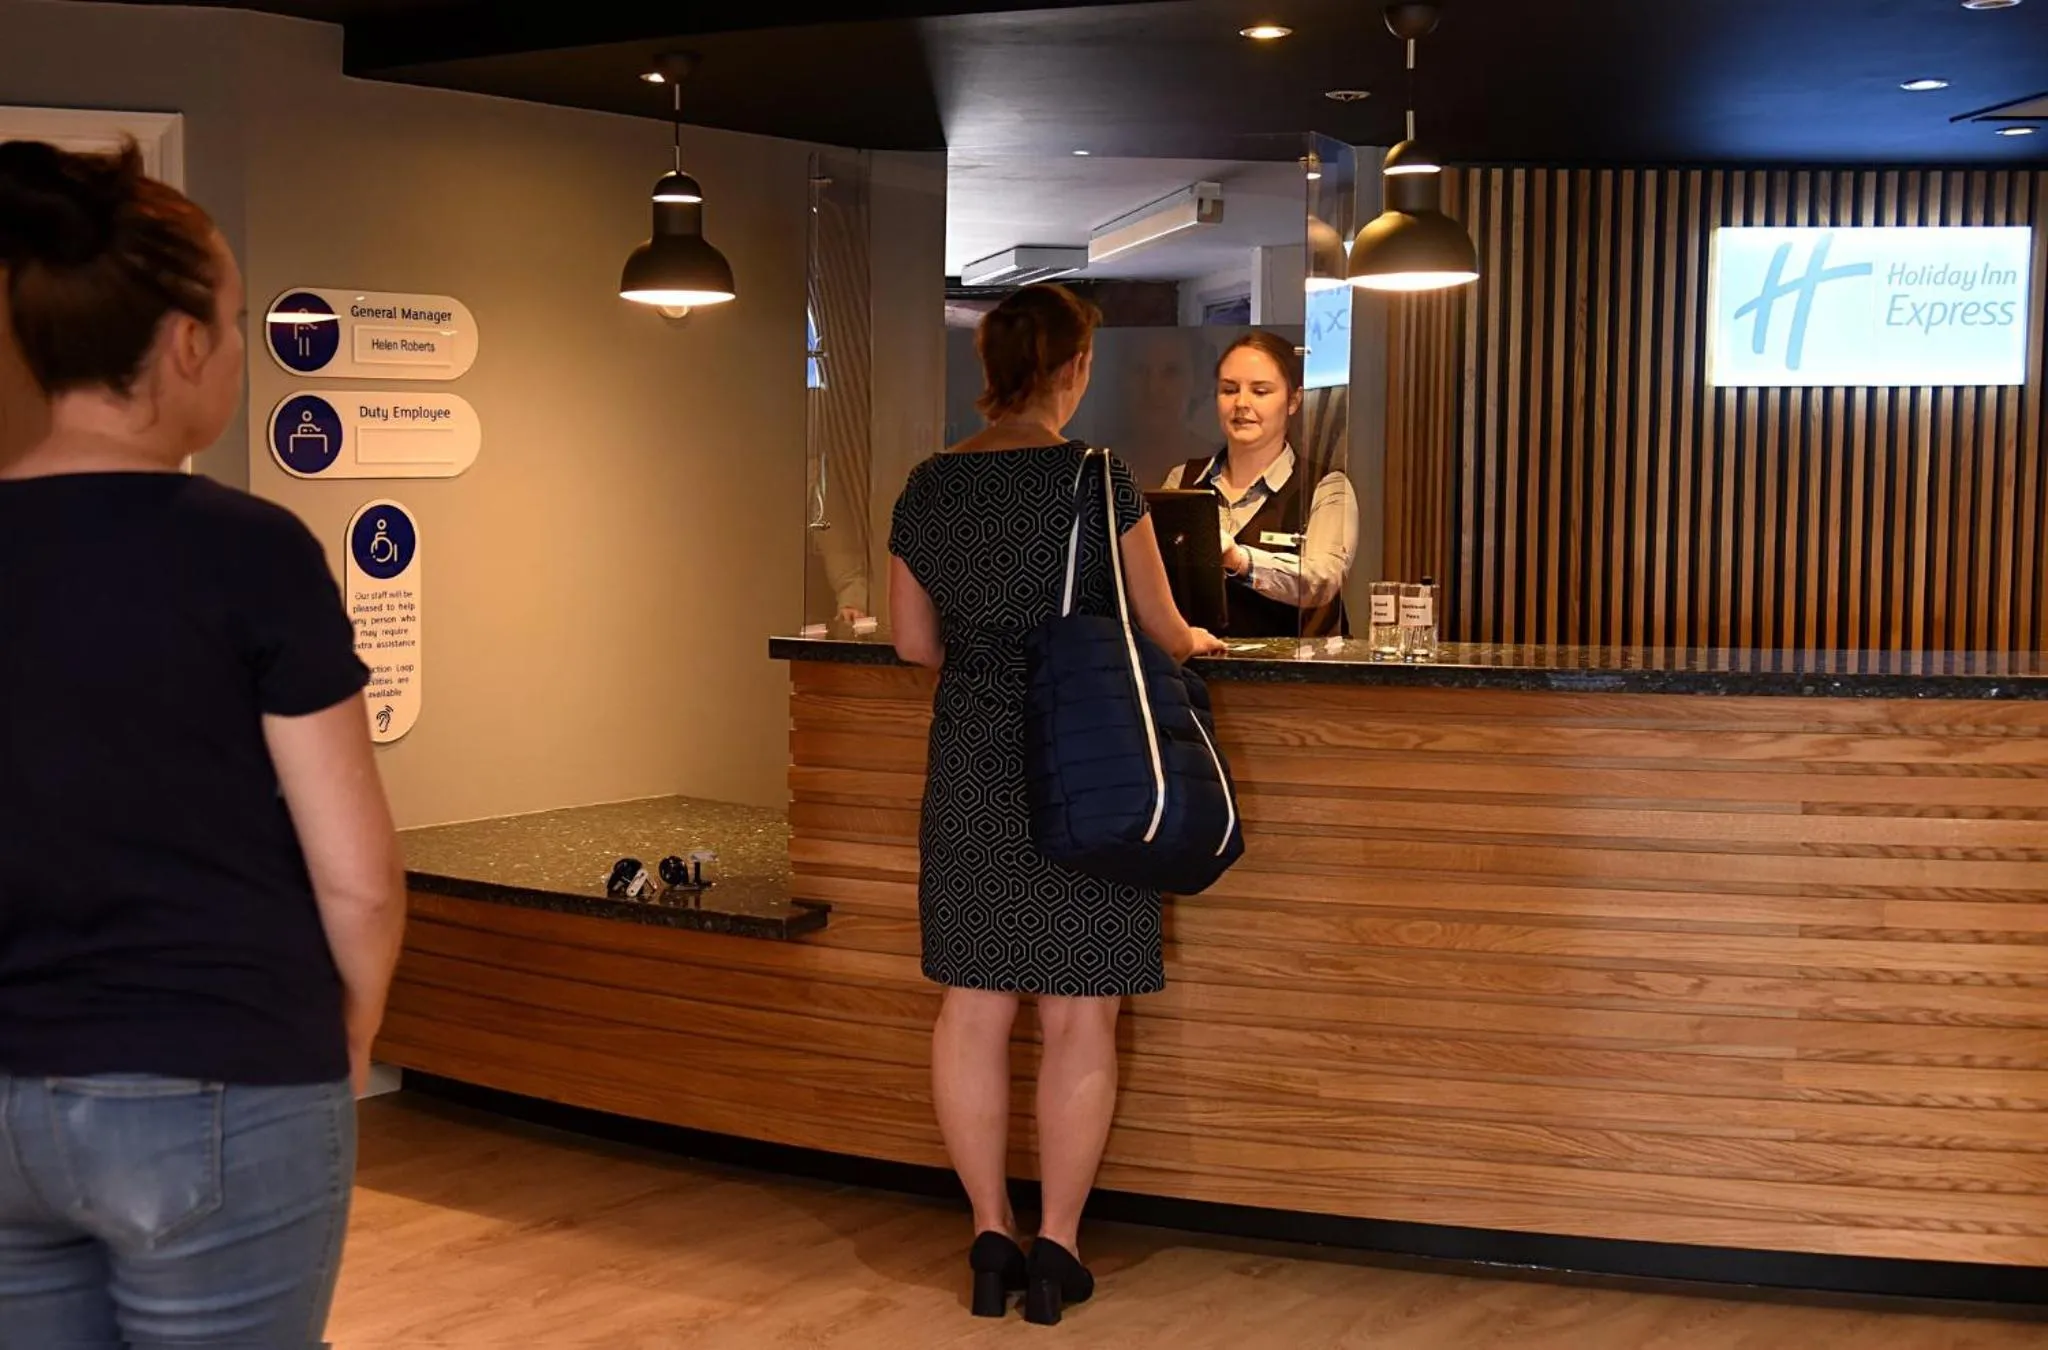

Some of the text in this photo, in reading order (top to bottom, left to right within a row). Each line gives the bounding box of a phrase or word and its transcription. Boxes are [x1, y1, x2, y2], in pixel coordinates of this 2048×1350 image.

[1888, 261, 2018, 291] Holiday Inn
[350, 305, 452, 324] General Manager
[1886, 294, 2017, 334] Express
[371, 339, 435, 352] Helen Roberts
[359, 406, 451, 422] Duty Employee
[354, 592, 370, 600] Our
[371, 591, 388, 600] staff
[403, 589, 413, 598] be
[353, 602, 416, 615] pleased to help
[370, 616, 397, 625] person
[400, 614, 416, 623] who
[360, 628, 408, 639] may require
[376, 640, 416, 649] assistance
